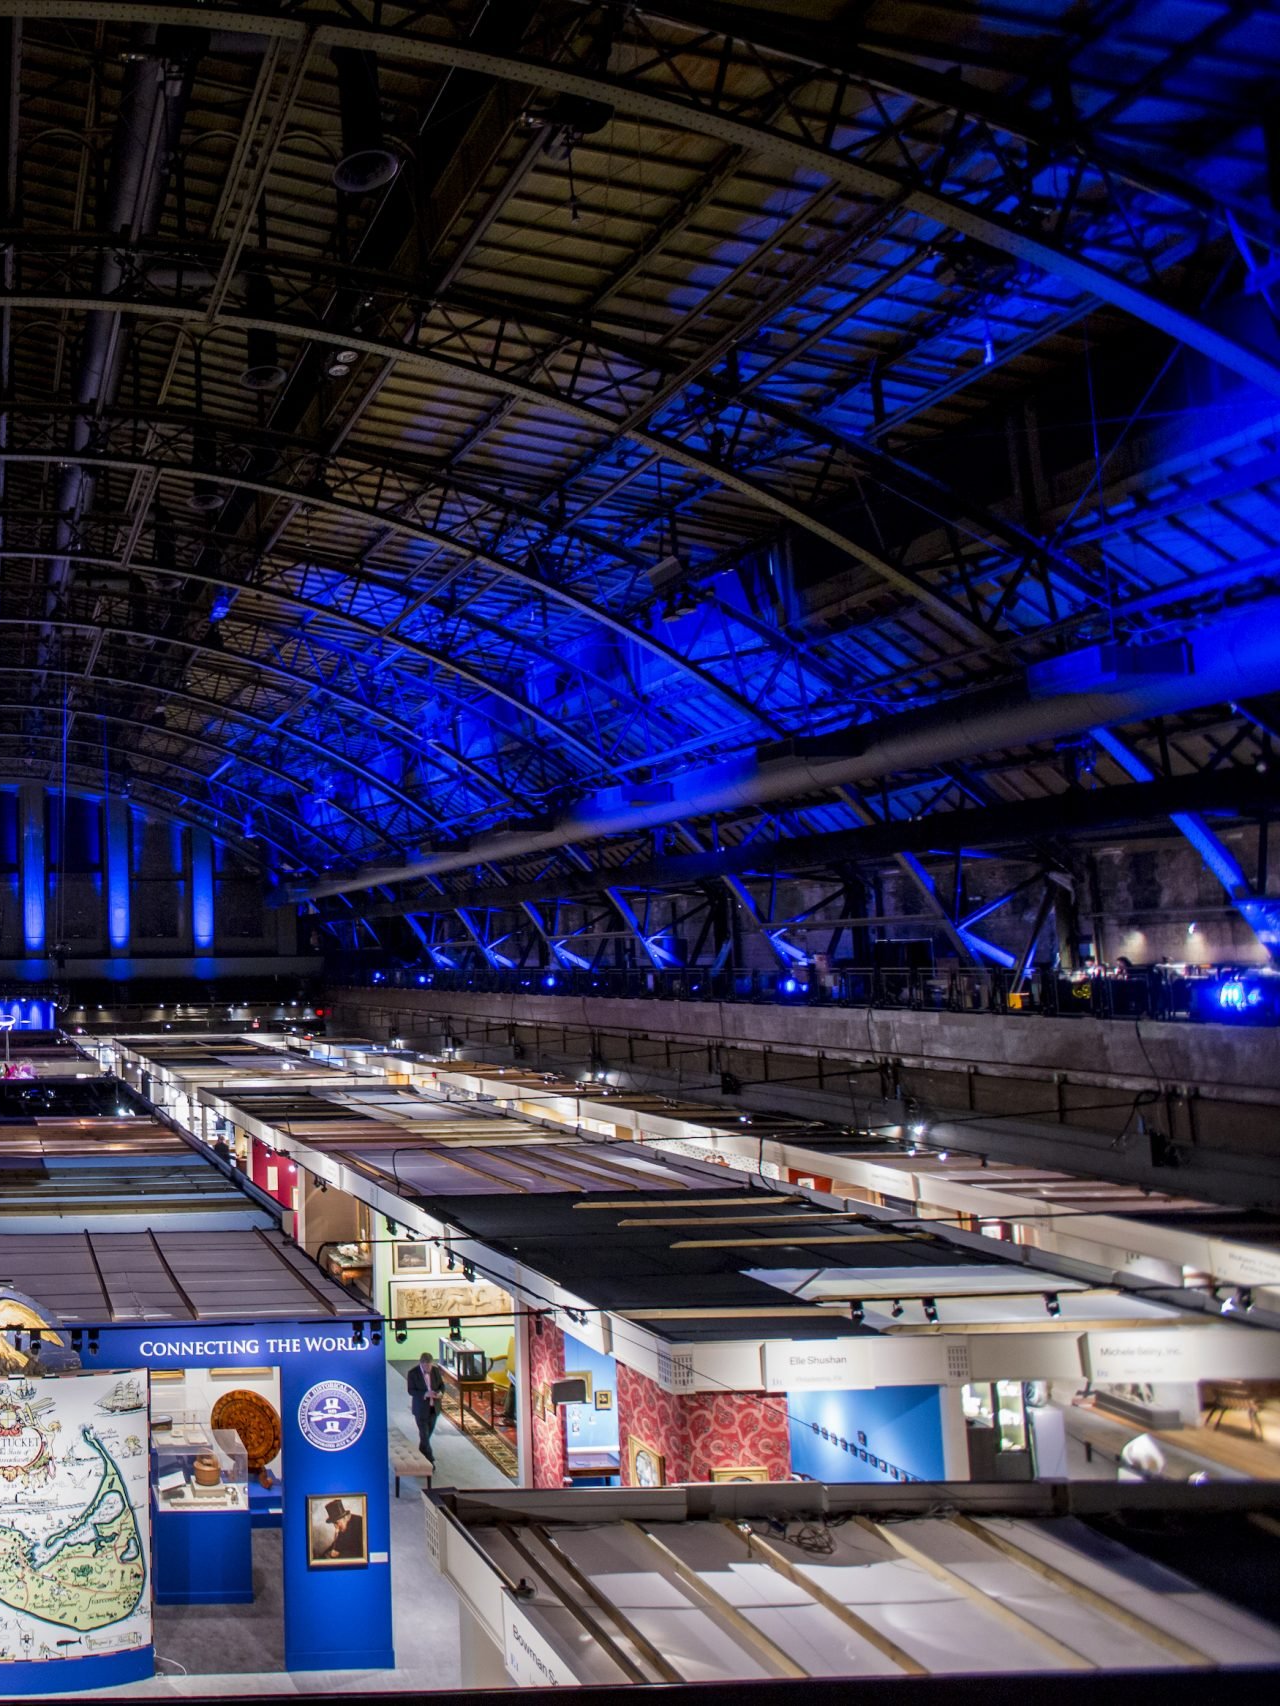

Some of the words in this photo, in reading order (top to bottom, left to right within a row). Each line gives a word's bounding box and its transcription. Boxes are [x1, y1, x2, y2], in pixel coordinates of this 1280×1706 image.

[139, 1340, 259, 1356] CONNECTING
[266, 1338, 300, 1353] THE
[304, 1336, 369, 1351] WORLD
[790, 1357, 805, 1366] Elle
[807, 1355, 847, 1365] Shushan
[512, 1623, 549, 1678] Bowman
